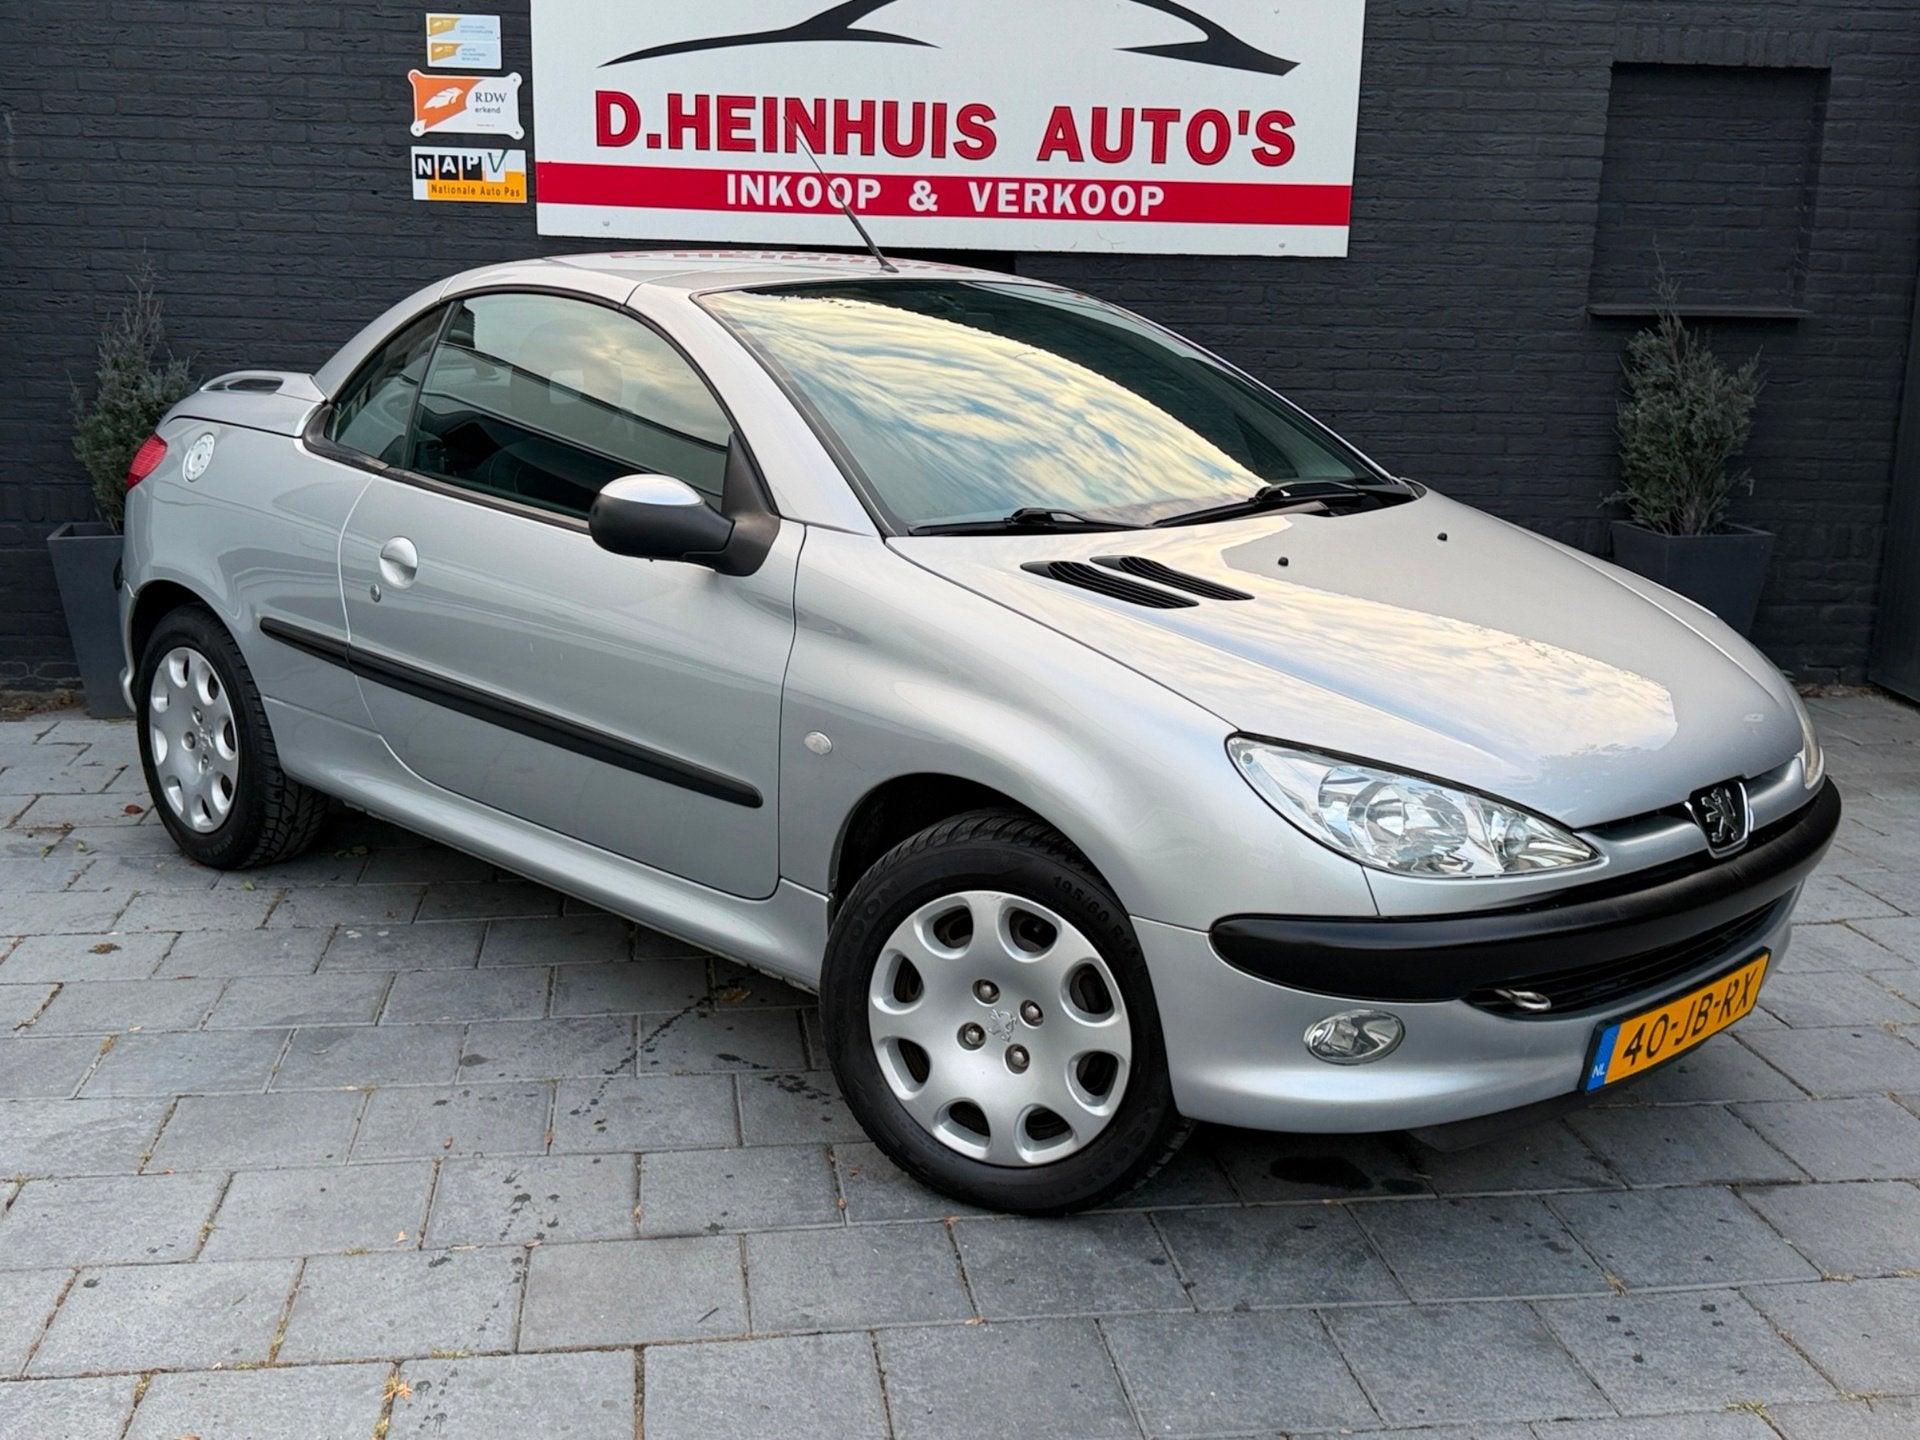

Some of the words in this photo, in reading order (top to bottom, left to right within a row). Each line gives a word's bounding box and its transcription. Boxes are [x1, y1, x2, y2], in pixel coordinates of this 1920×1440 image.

[475, 92, 507, 103] RDW
[475, 106, 501, 114] erkend
[595, 90, 998, 161] D.HEINHUIS
[1036, 102, 1296, 167] AUTO'S
[431, 184, 476, 195] Nationale
[480, 186, 501, 196] Auto
[504, 187, 520, 197] Pas
[727, 173, 882, 210] INKOOP
[908, 180, 938, 212] &
[967, 181, 1165, 216] VERKOOP
[1052, 875, 1109, 922] 195/60
[1622, 967, 1759, 1067] 40-JB-RX
[1591, 1063, 1606, 1079] NL
